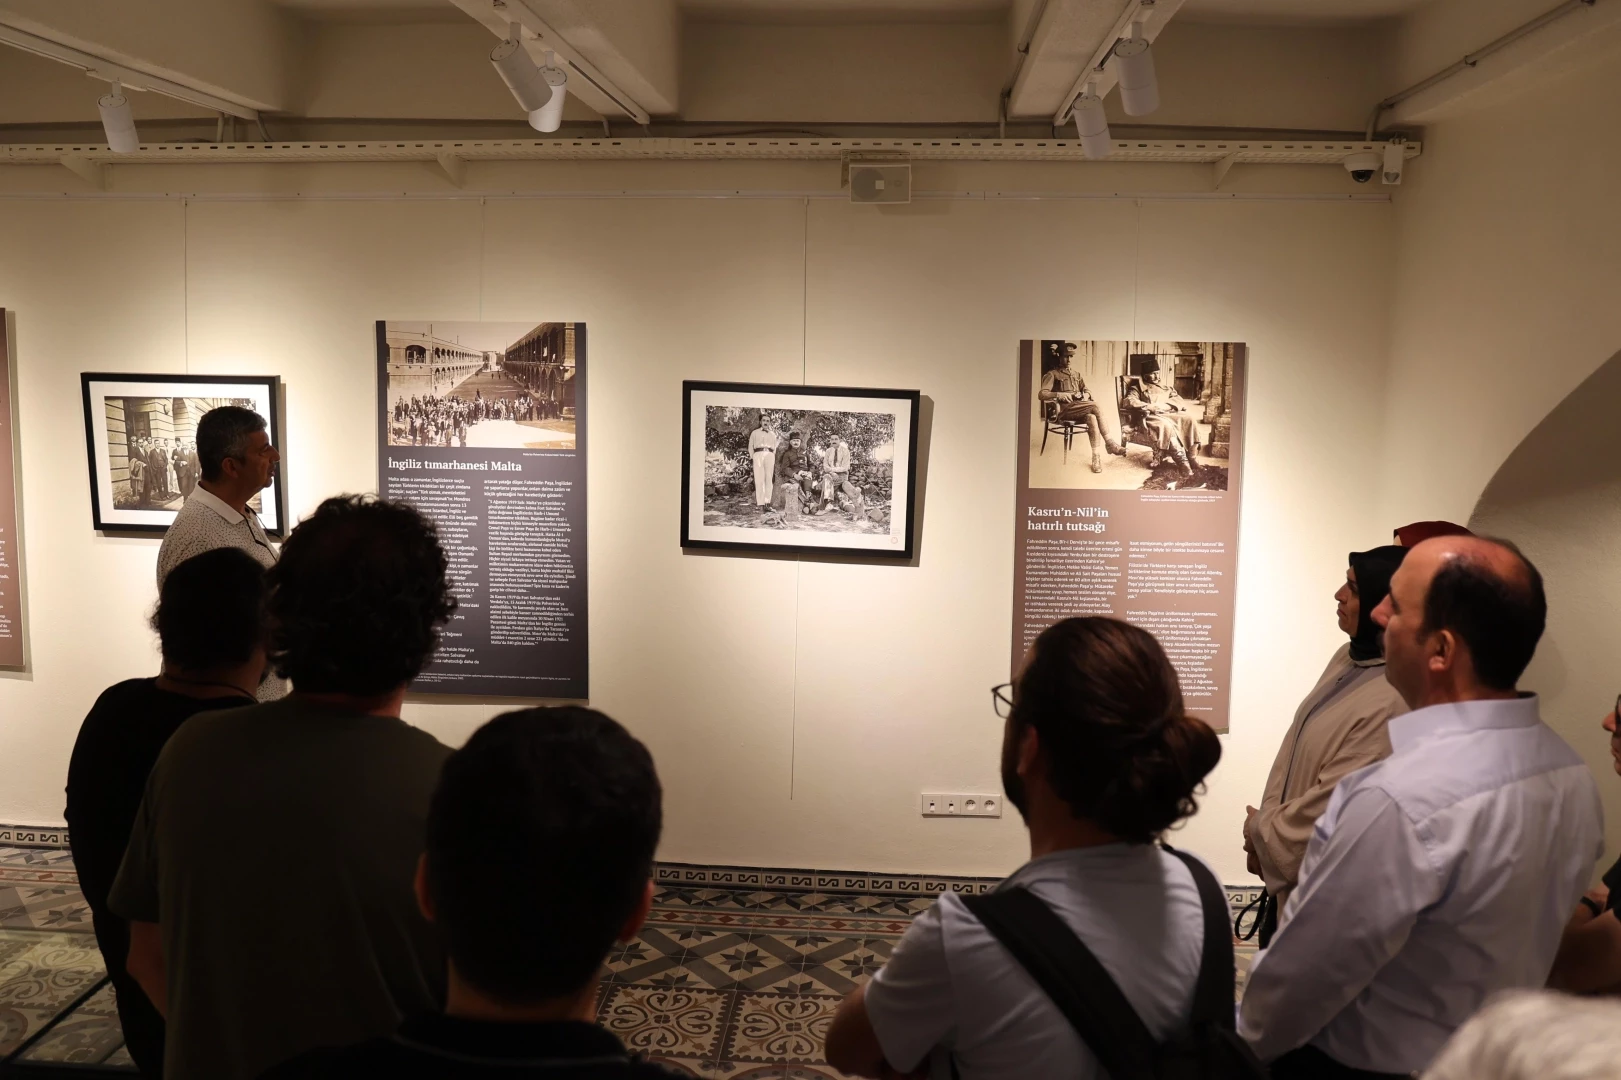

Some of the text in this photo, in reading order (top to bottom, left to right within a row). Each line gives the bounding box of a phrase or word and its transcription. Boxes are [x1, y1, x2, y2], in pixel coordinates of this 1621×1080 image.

[388, 456, 522, 471] İngiliz tımarhanesi Malta
[1028, 520, 1105, 533] hatırlı tutsağı
